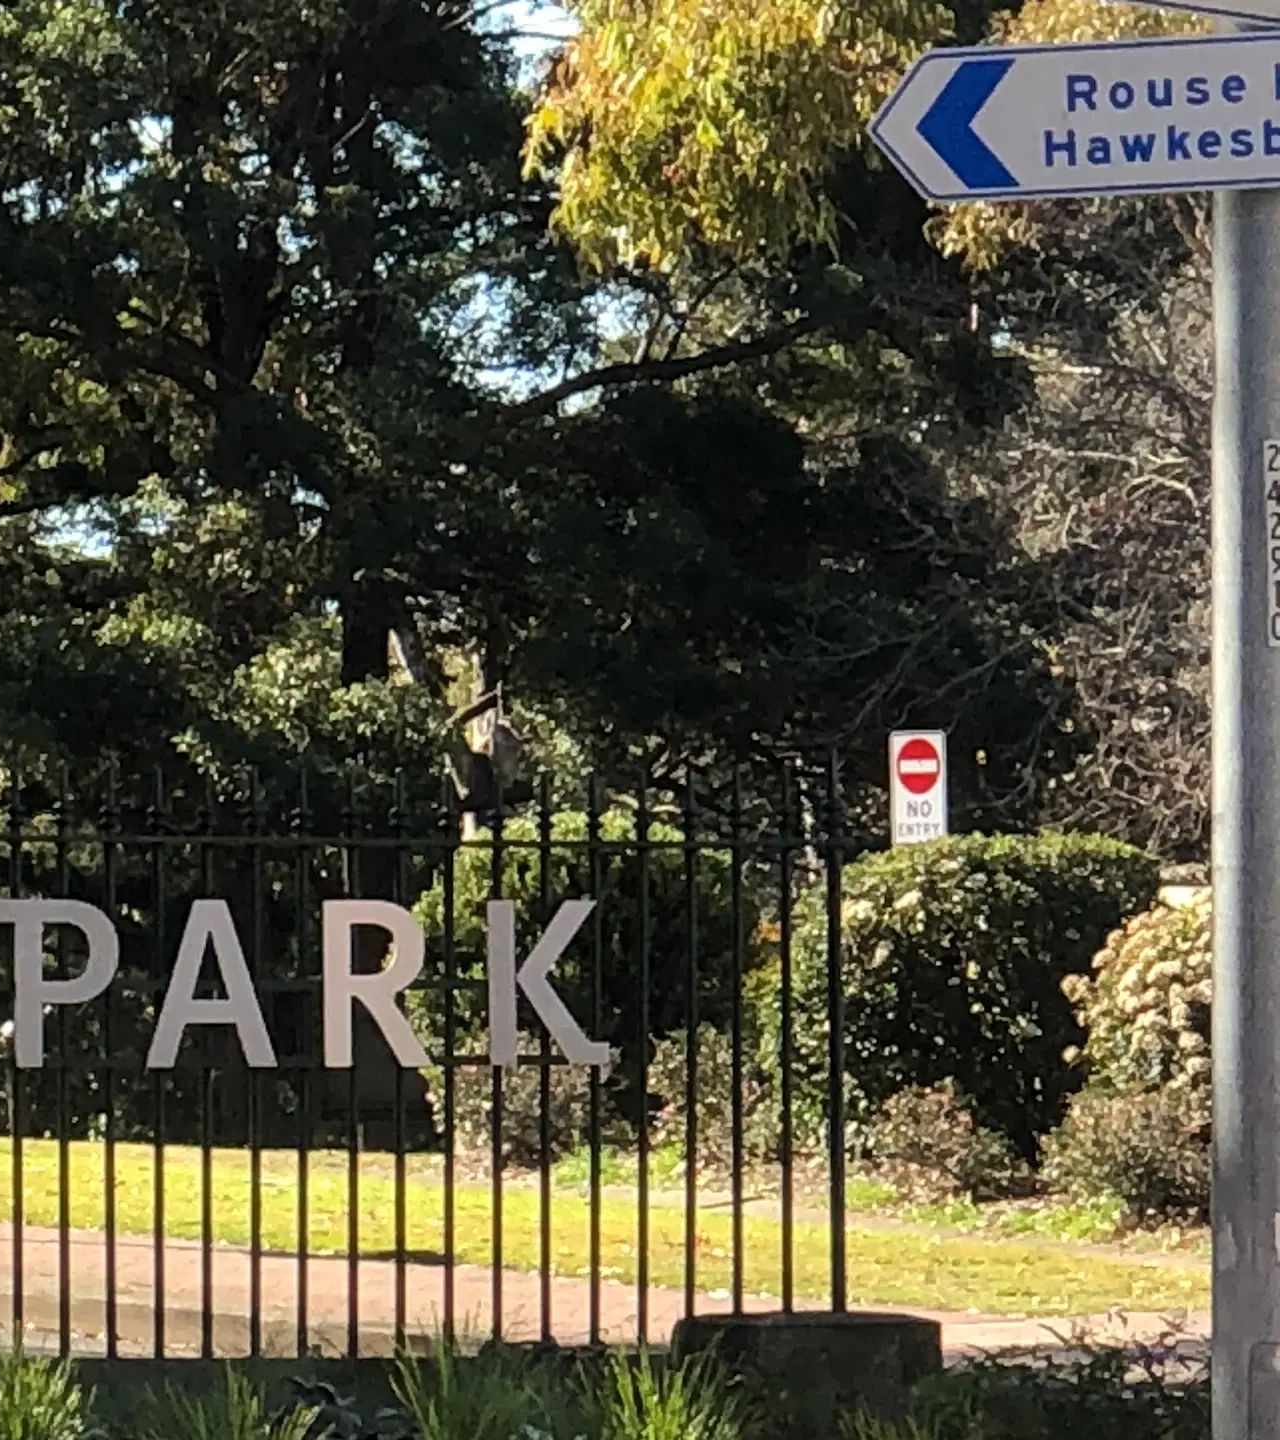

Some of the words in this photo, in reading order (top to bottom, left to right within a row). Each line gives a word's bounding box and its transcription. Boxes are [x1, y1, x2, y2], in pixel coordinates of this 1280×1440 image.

[1066, 74, 1247, 112] Rouse
[906, 800, 933, 818] NO
[898, 822, 941, 837] ENTRY
